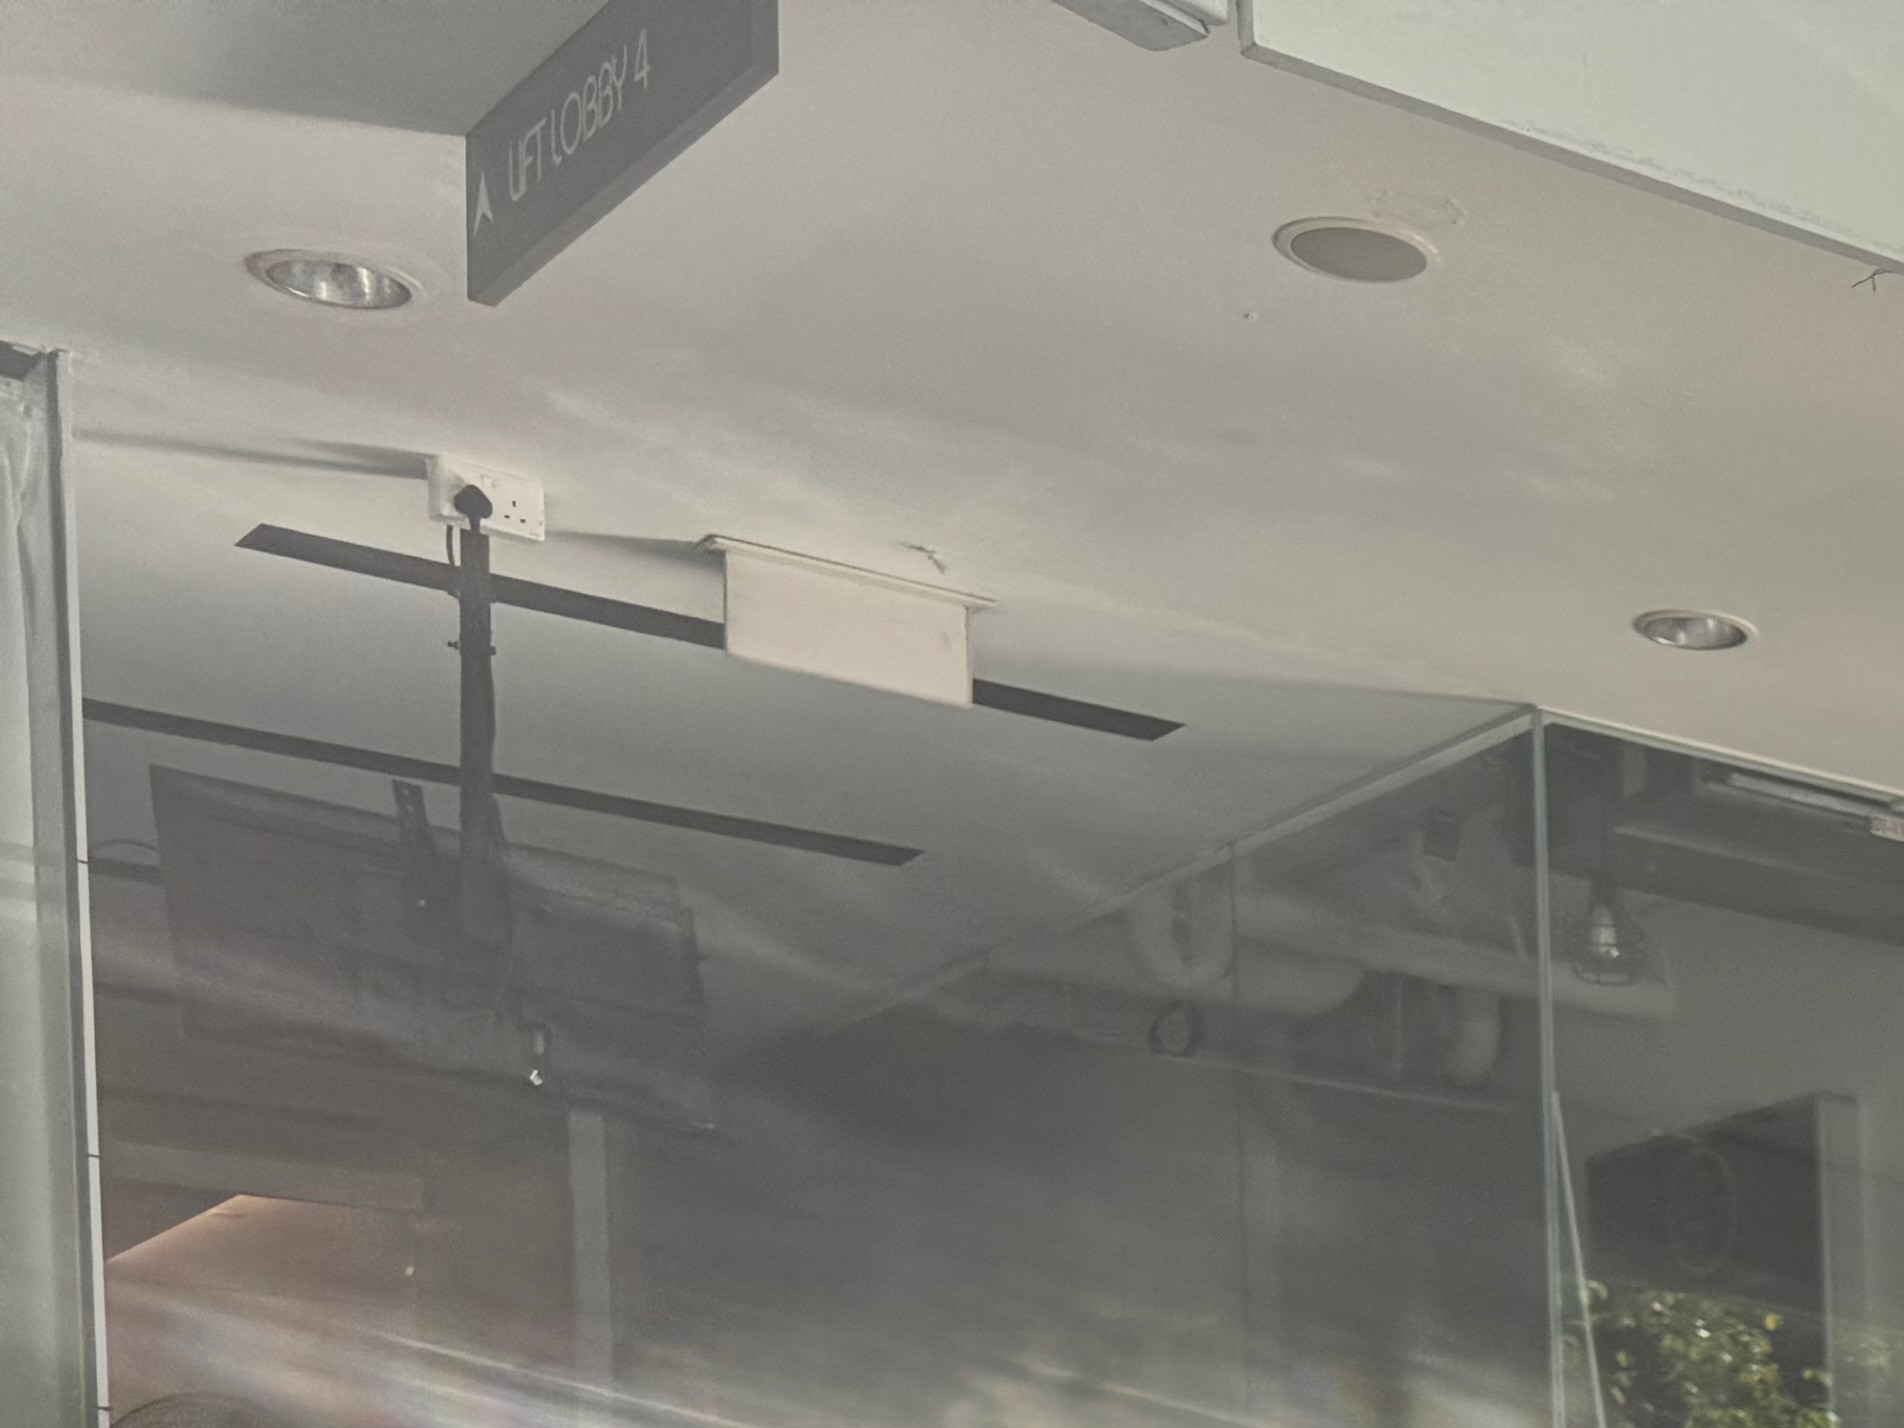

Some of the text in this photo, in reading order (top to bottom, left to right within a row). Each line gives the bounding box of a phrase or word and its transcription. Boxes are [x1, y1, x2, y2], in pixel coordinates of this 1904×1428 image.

[508, 28, 650, 201] LIFT LOBBY 4
